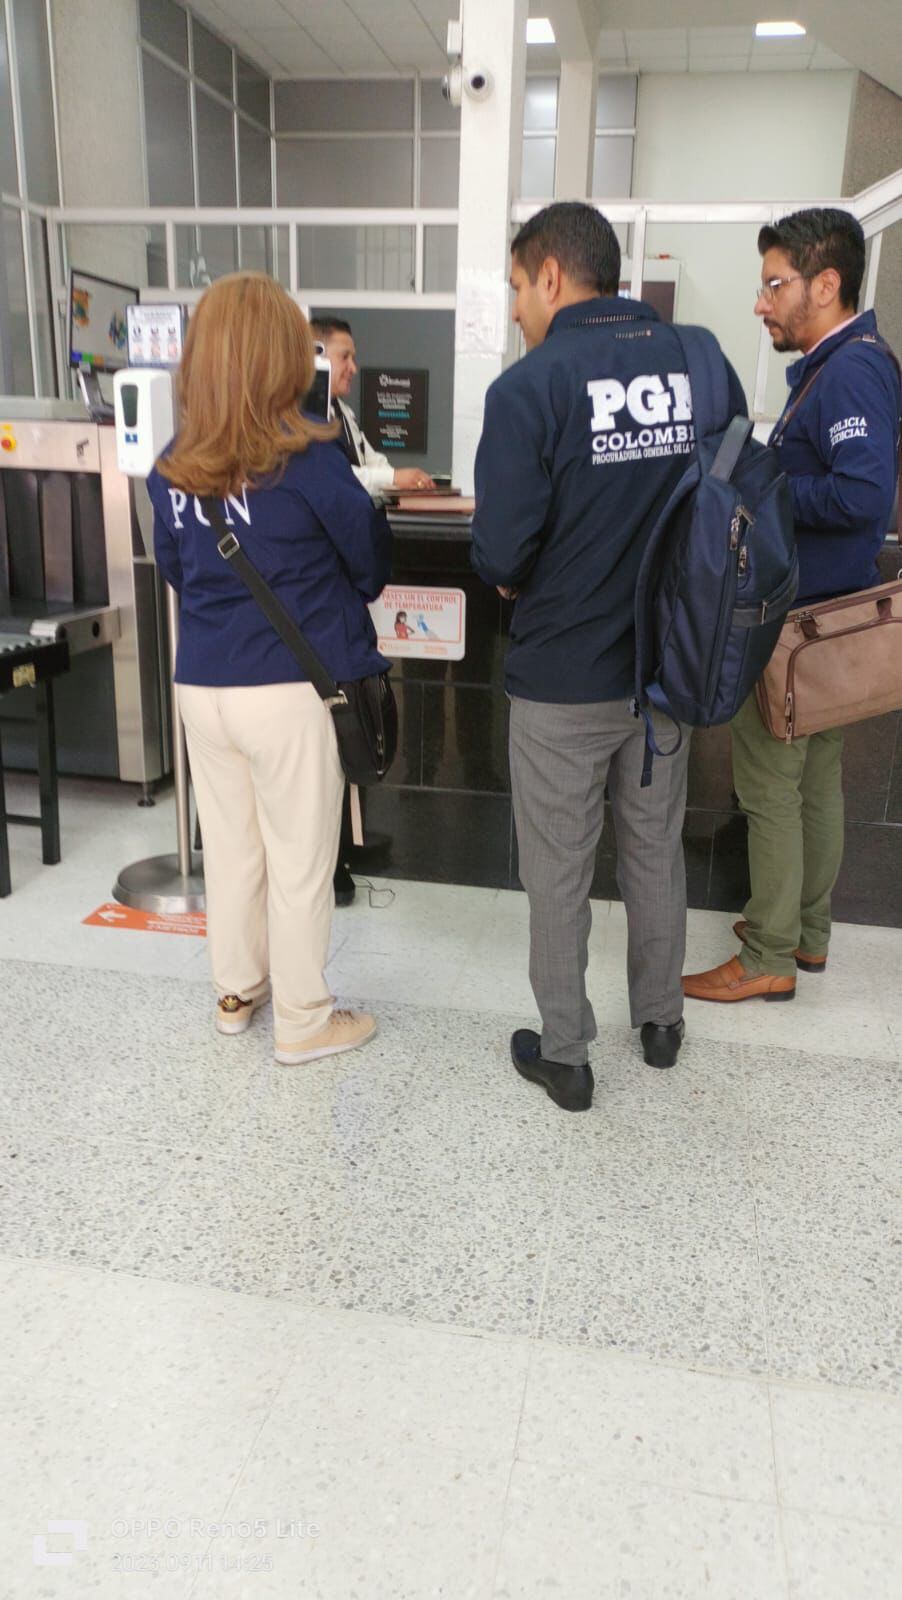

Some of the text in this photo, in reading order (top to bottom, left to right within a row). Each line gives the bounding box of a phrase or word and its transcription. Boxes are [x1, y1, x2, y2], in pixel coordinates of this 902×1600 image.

[829, 416, 867, 438] POLICIA
[592, 424, 695, 453] COLOMBI
[831, 427, 868, 448] UDICIAL
[643, 445, 673, 458] GENERAL
[404, 591, 416, 601] SIN
[417, 592, 426, 601] EL
[427, 592, 456, 604] CONTROL
[395, 602, 444, 612] TEMPERATURA
